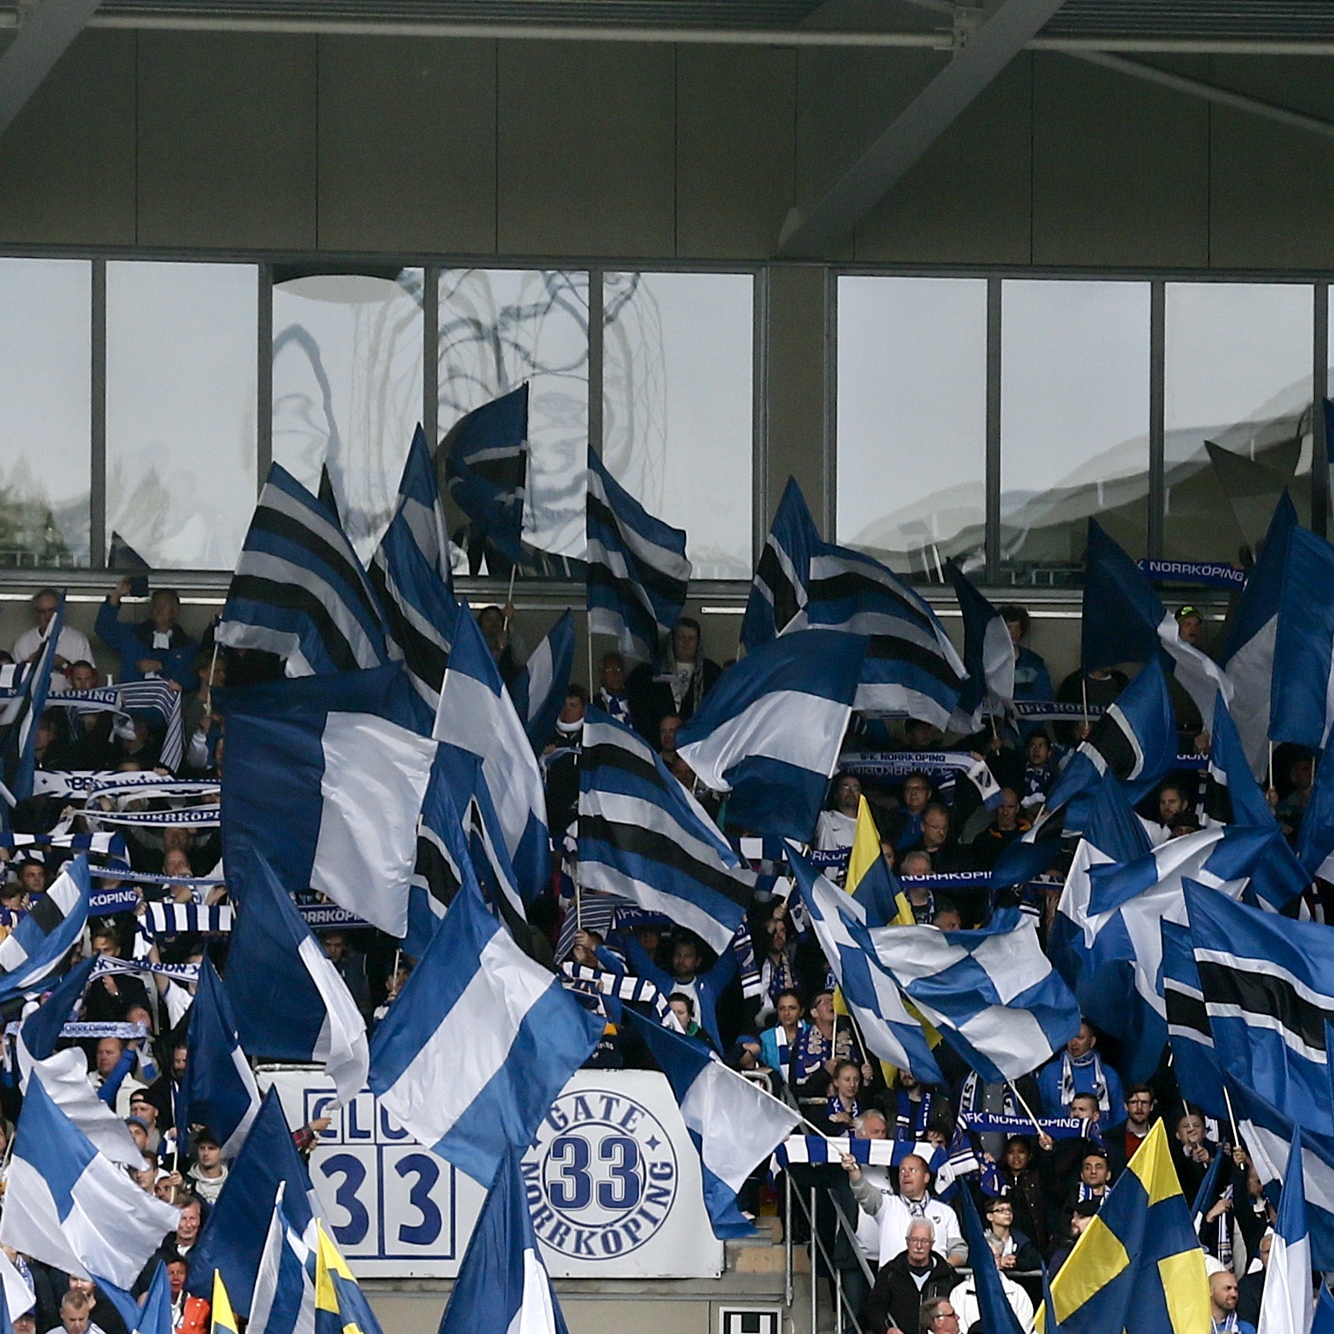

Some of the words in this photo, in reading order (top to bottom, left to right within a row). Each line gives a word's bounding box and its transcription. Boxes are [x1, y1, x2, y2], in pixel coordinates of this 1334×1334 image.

[1149, 561, 1245, 582] NORRKÖPING
[1053, 703, 1106, 714] NORR
[126, 809, 221, 823] NORRKÖPI
[545, 1094, 647, 1134] GATE
[548, 1136, 643, 1211] 33
[320, 1153, 443, 1246] 33
[521, 1160, 675, 1258] NORRKÖPING
